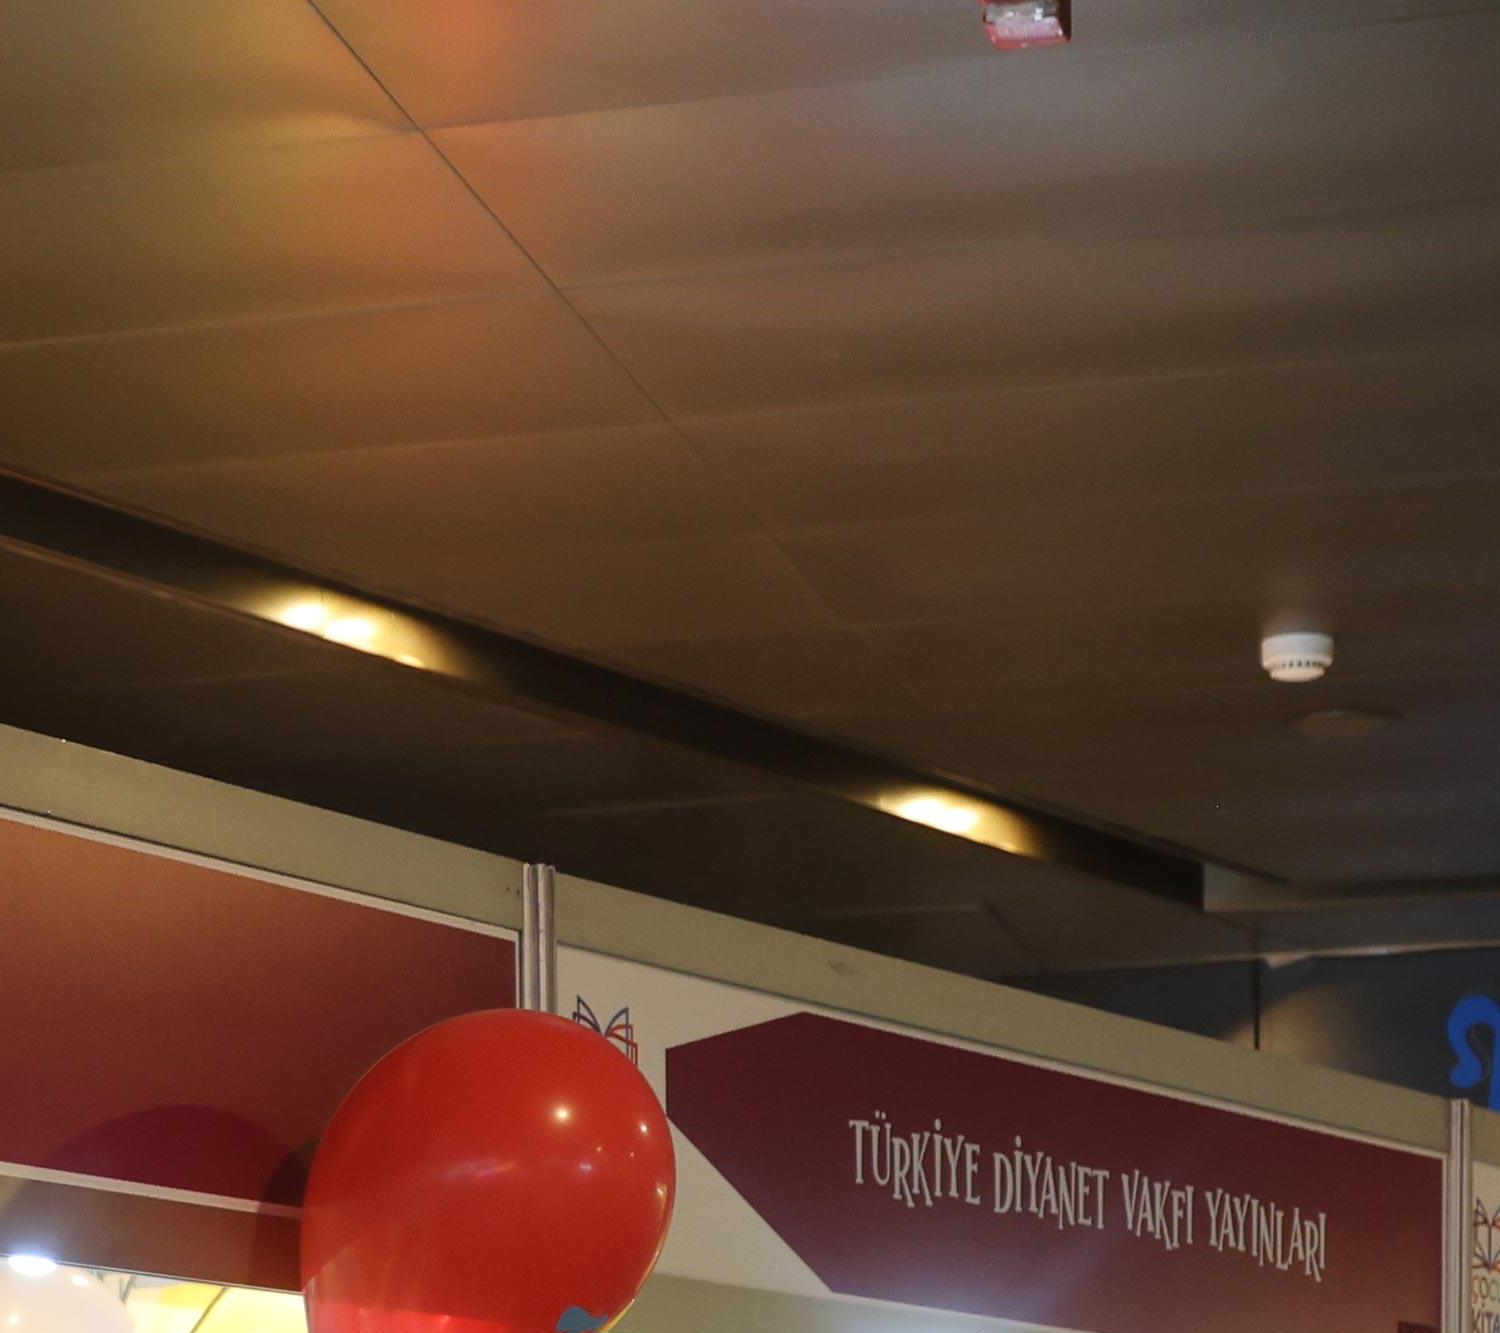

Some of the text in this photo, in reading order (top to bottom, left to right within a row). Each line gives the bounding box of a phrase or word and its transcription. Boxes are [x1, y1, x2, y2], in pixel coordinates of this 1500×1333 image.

[848, 1109, 1328, 1284] TÜRKİYE DİYANET VAKFI YAYINLARI
